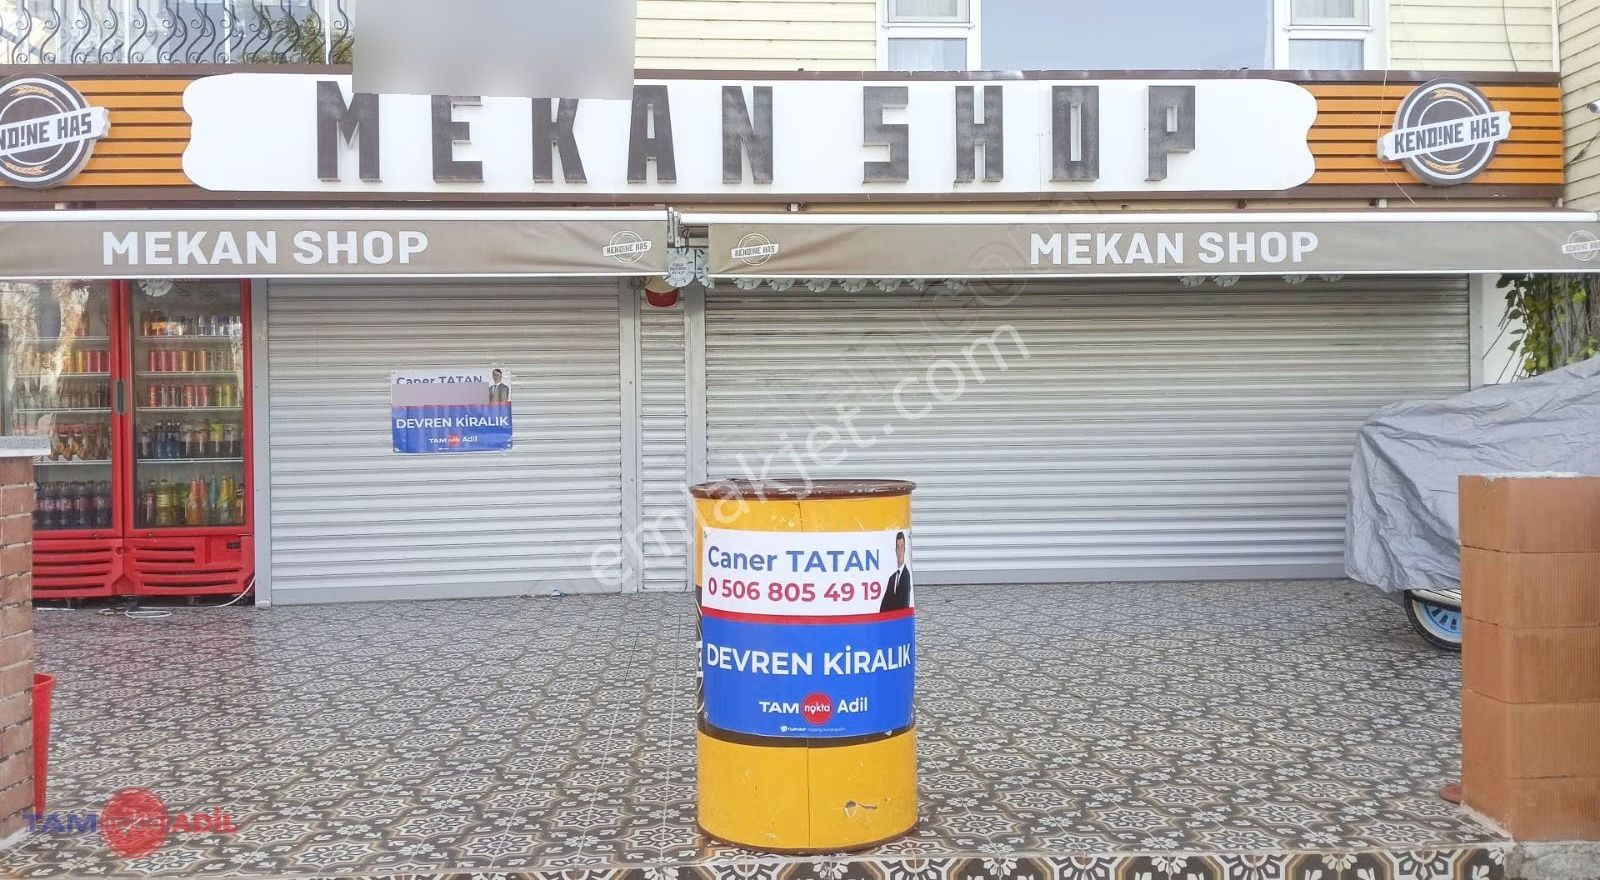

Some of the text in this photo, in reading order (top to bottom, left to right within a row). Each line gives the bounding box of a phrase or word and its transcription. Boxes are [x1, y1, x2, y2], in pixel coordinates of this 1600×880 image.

[57, 113, 92, 139] HAS
[316, 80, 1196, 185] MEKAN SHOP
[1470, 116, 1500, 140] HAS
[102, 229, 429, 266] MEKAN SHOP
[1030, 231, 1319, 265] MEKAN SHOP
[438, 375, 482, 384] TATAN
[396, 414, 509, 429] DEVREN KİRALIK
[708, 545, 879, 573] Caner TATAN
[708, 577, 882, 602] 0 506 805 49 19
[706, 643, 911, 676] DEVREN KİRALIK
[758, 696, 868, 715] TAM nokta Adil
